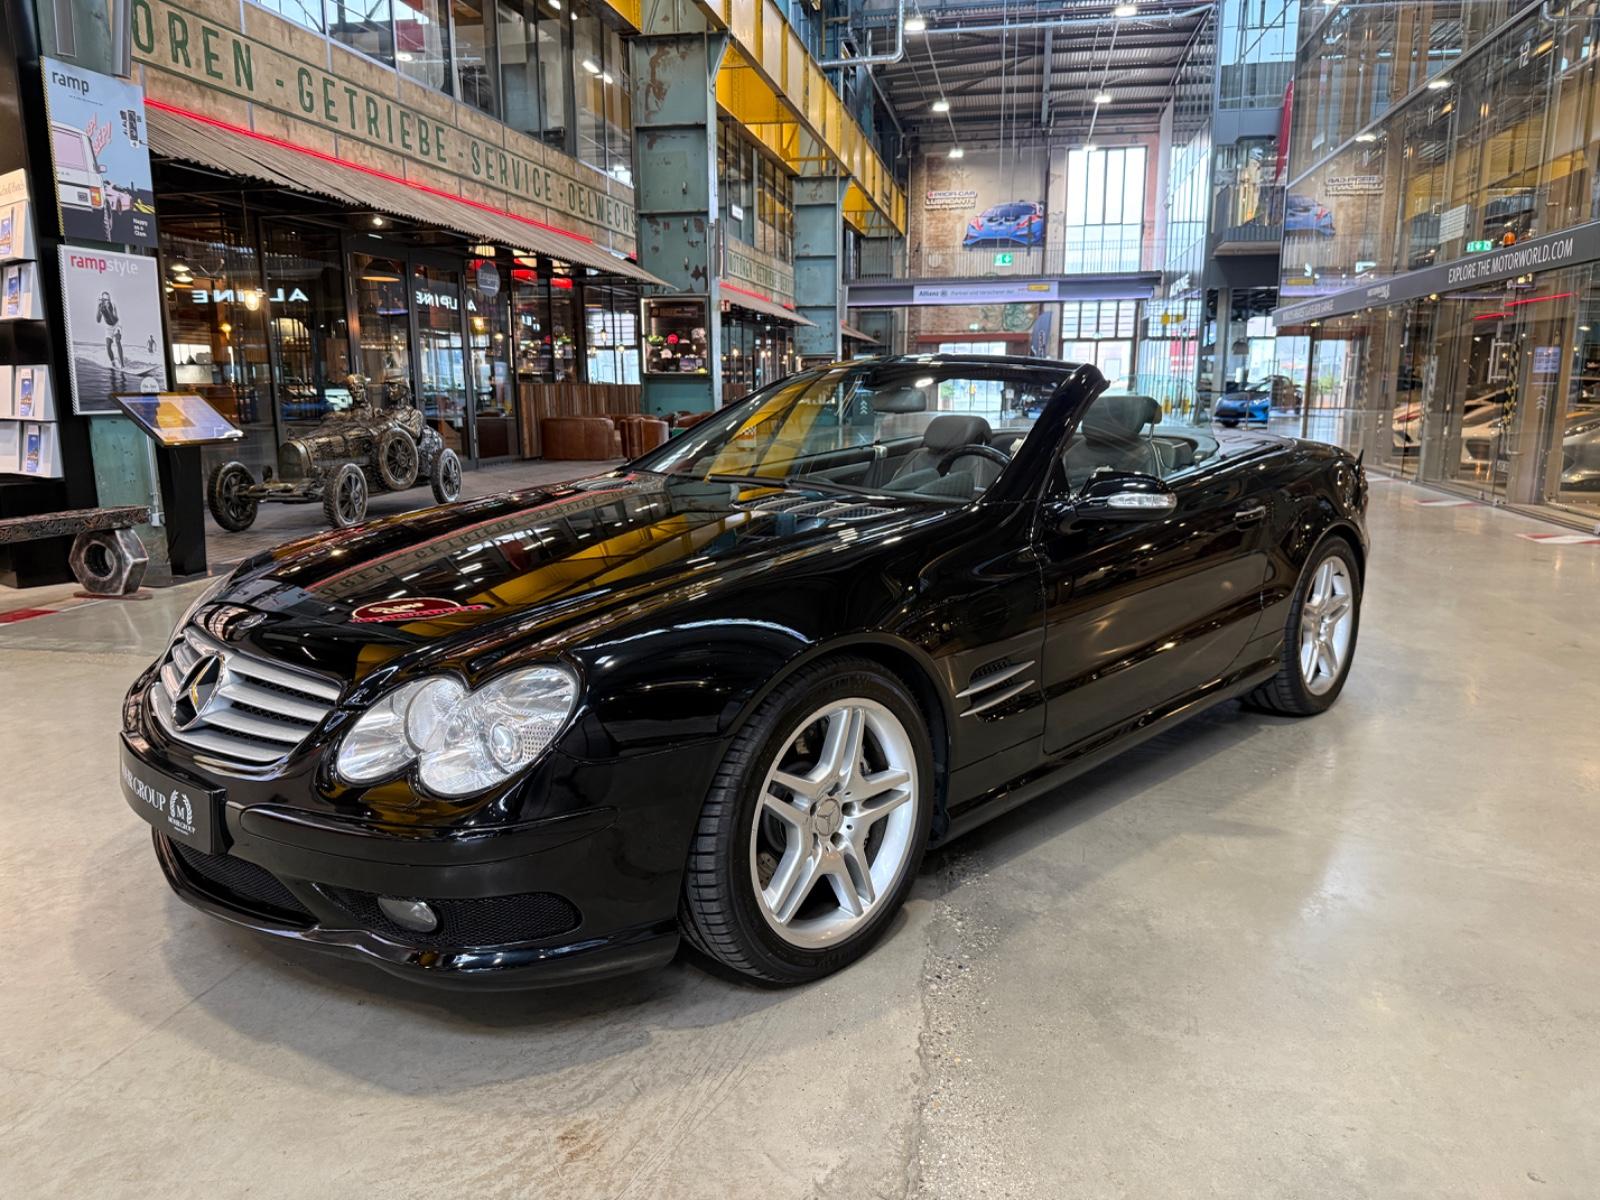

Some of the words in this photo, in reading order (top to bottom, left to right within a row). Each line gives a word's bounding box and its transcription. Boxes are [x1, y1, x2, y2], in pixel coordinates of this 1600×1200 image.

[52, 71, 90, 96] ramp
[297, 66, 447, 163] GETRIEBE
[471, 141, 552, 201] SERVICE
[70, 255, 139, 277] rampstyle
[1448, 262, 1477, 283] EXPLORE
[1477, 259, 1490, 277] THE
[1491, 238, 1574, 274] MOTORWORLD.COM
[133, 776, 166, 811] GROUP
[176, 804, 185, 820] M
